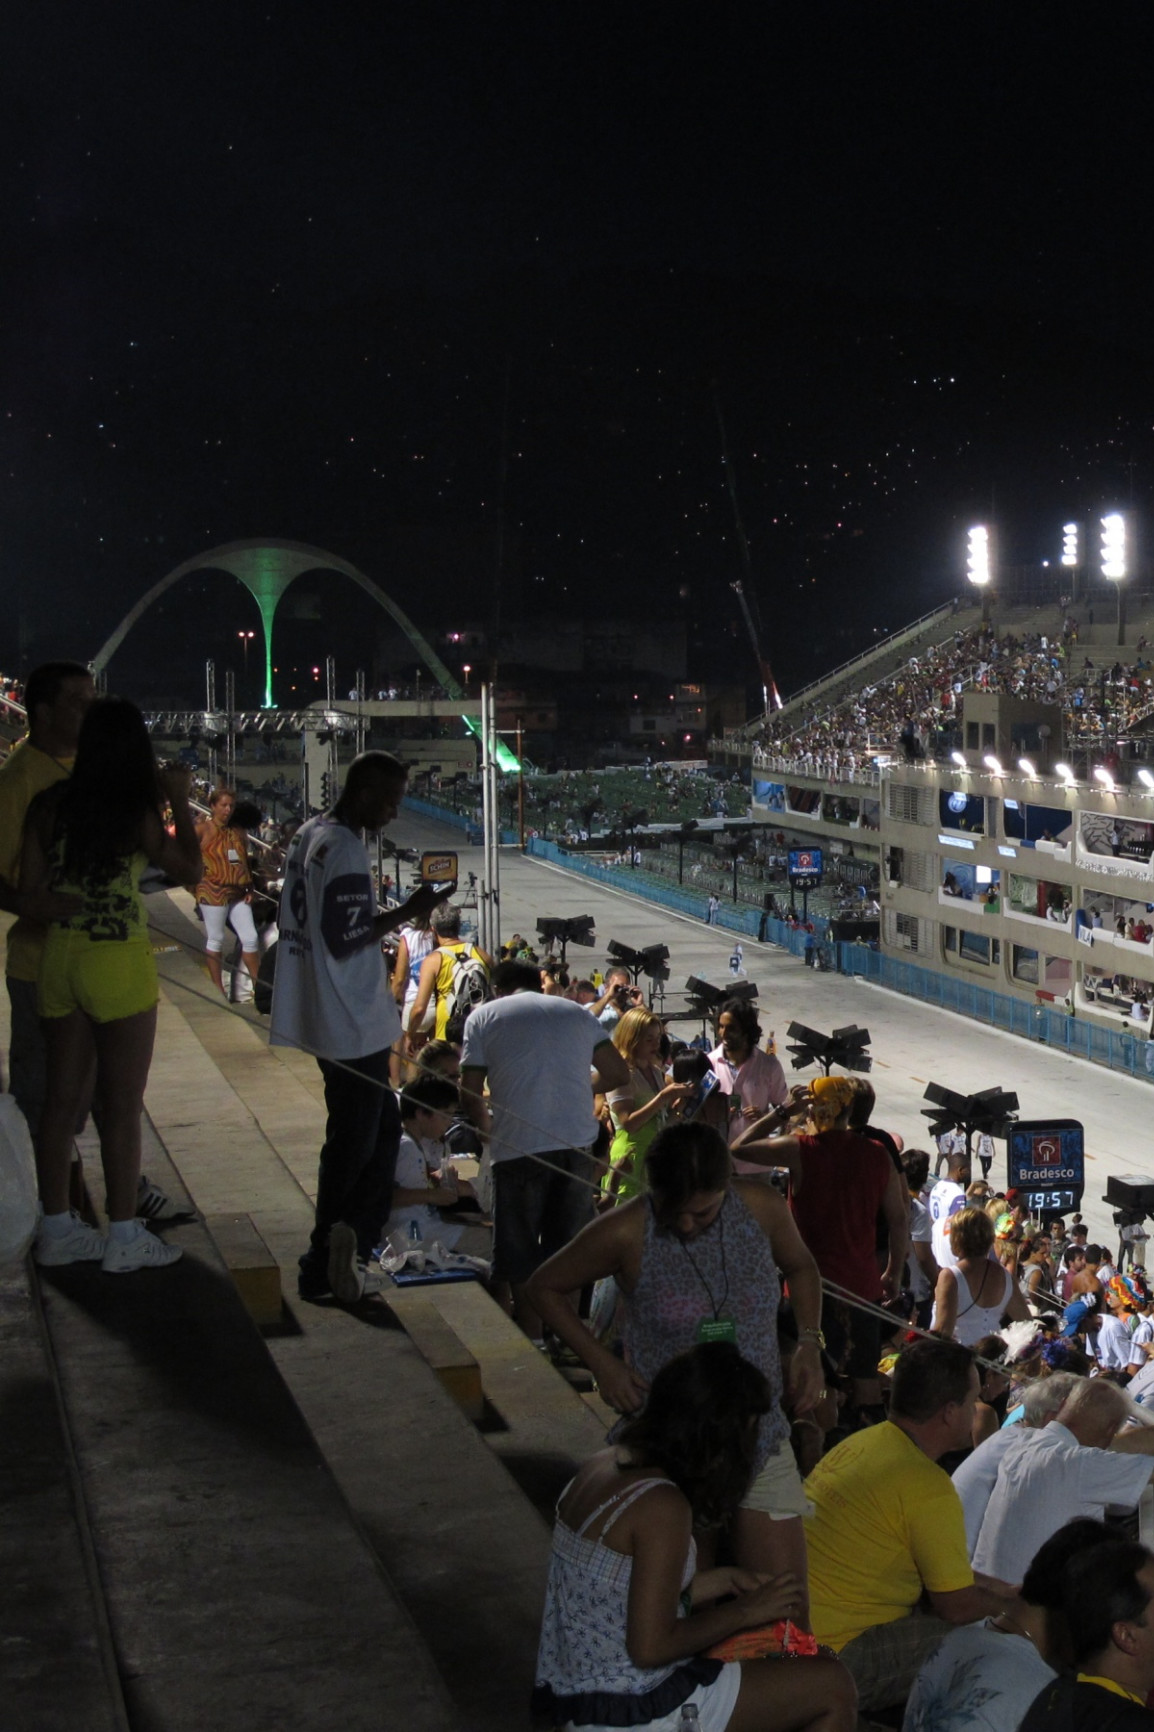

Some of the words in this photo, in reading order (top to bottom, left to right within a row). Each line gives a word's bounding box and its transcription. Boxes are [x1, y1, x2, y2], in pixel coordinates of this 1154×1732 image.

[336, 893, 369, 902] SETOR
[347, 906, 361, 927] 7
[343, 925, 370, 941] LIESA
[1020, 1168, 1074, 1180] Bradesco
[1029, 1191, 1073, 1208] 19:57
